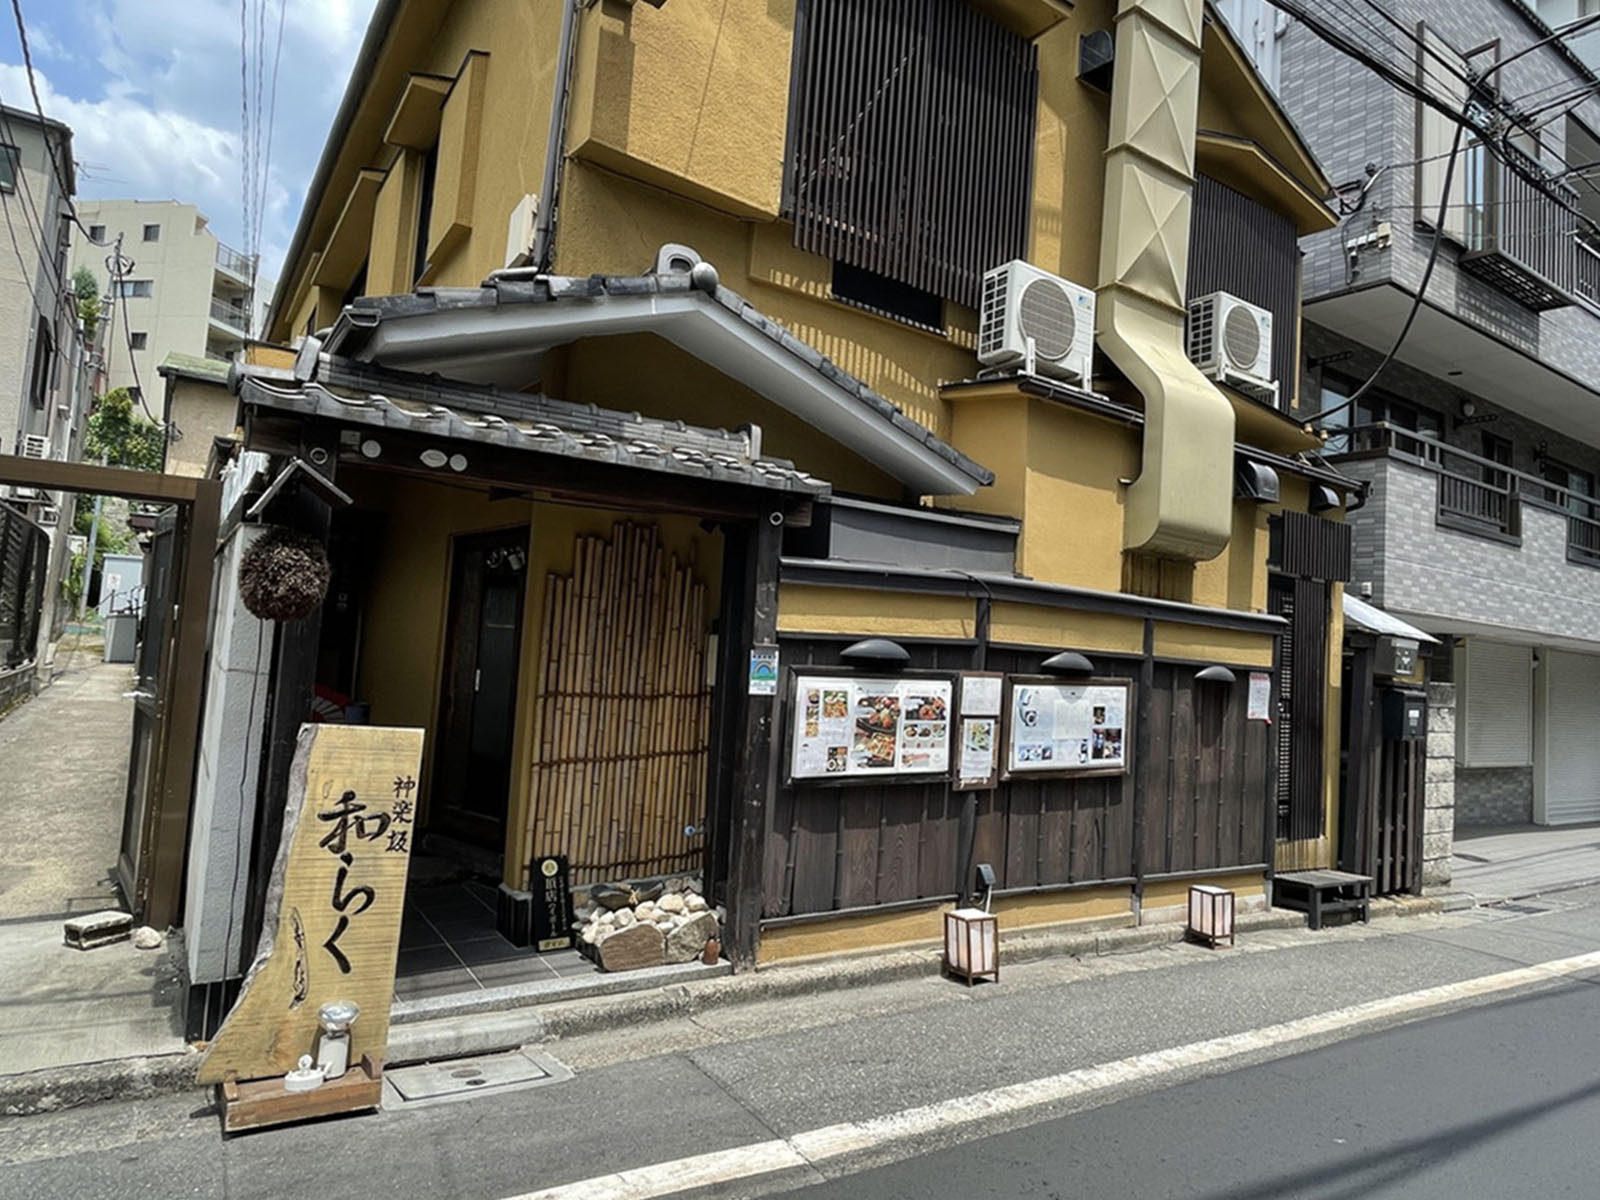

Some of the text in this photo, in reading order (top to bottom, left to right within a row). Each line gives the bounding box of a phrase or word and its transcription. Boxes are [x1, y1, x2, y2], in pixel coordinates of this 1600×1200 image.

[385, 776, 416, 853] 神楽坂
[317, 790, 391, 974] 和らく
